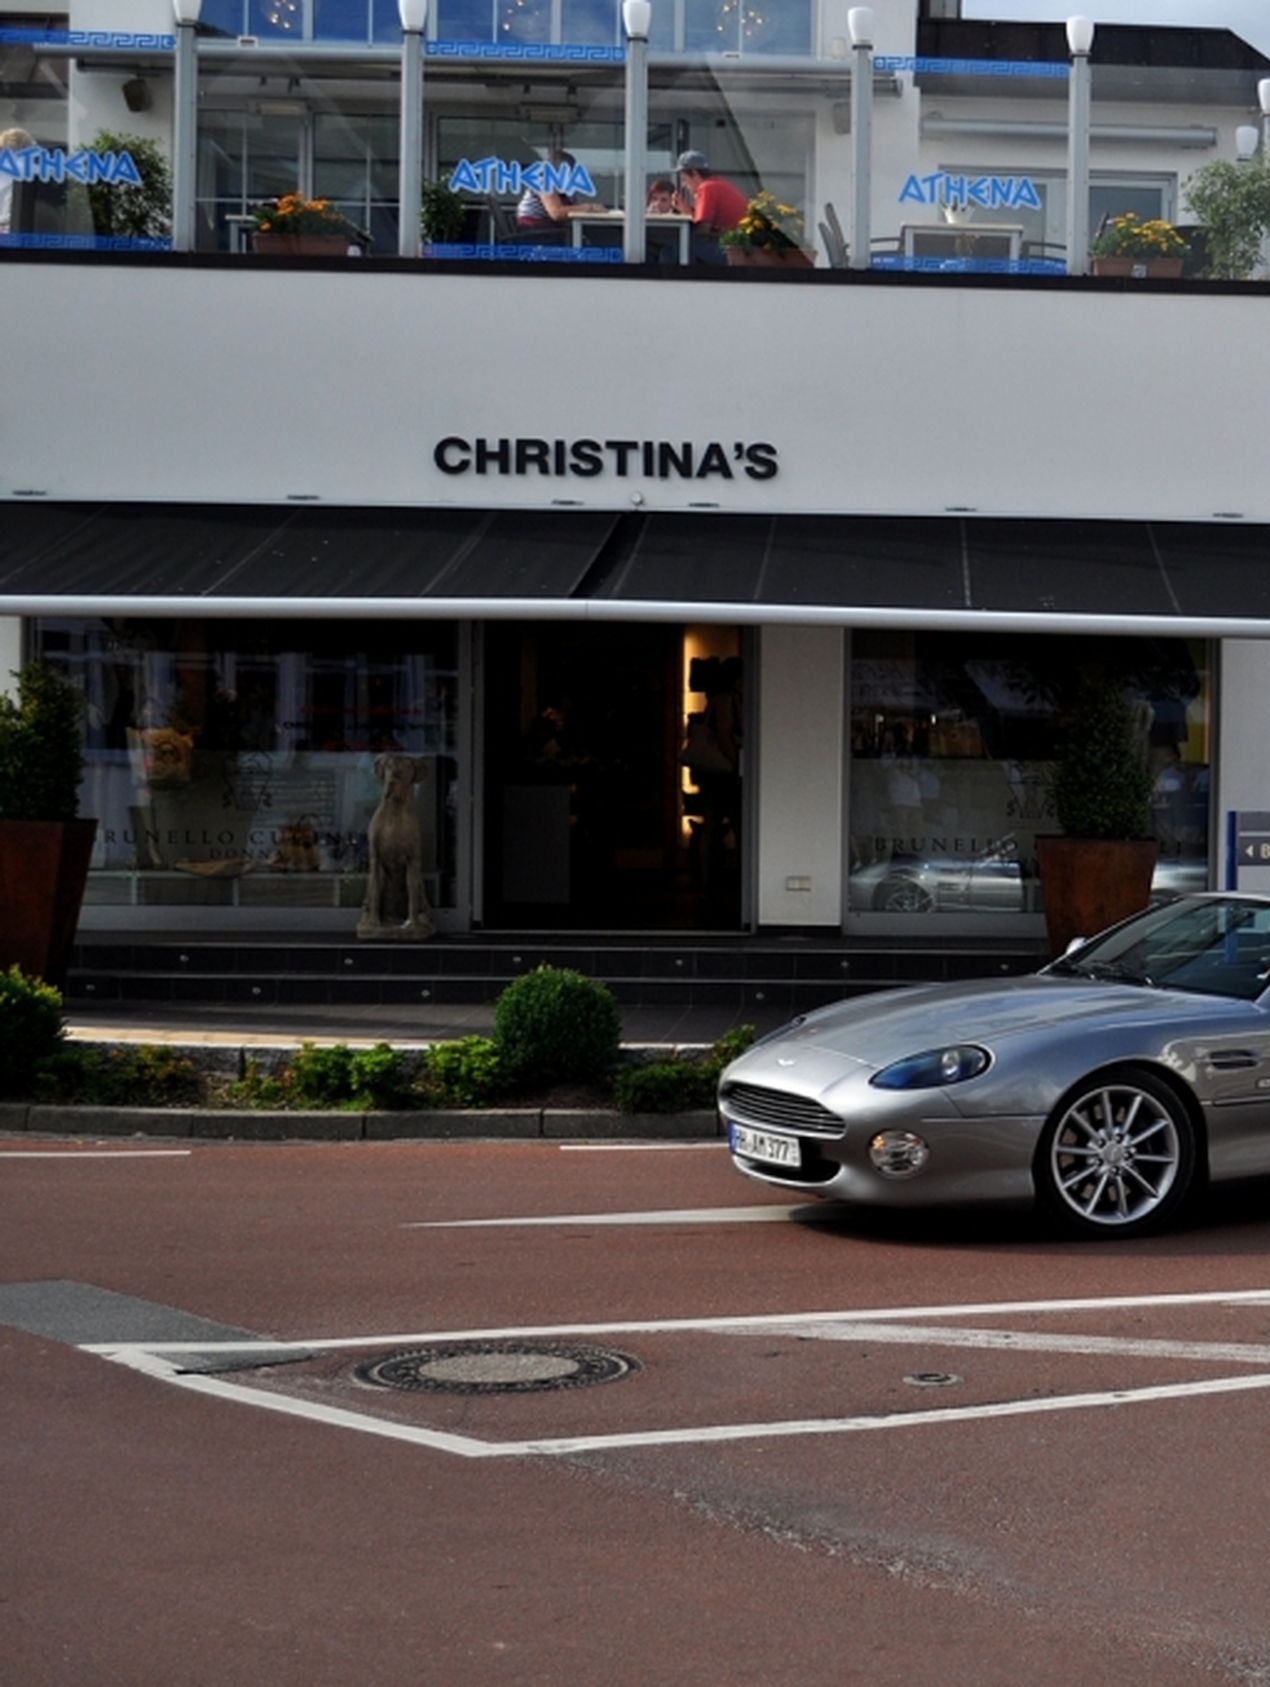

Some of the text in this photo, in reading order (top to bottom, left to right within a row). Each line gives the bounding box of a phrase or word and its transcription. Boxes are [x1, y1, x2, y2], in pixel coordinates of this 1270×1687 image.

[0, 146, 142, 186] ATHENA
[449, 155, 597, 197] ATHENA
[898, 171, 1041, 210] ATHENA
[433, 436, 780, 480] CHRISTINA'S
[96, 829, 234, 845] RUNELLO
